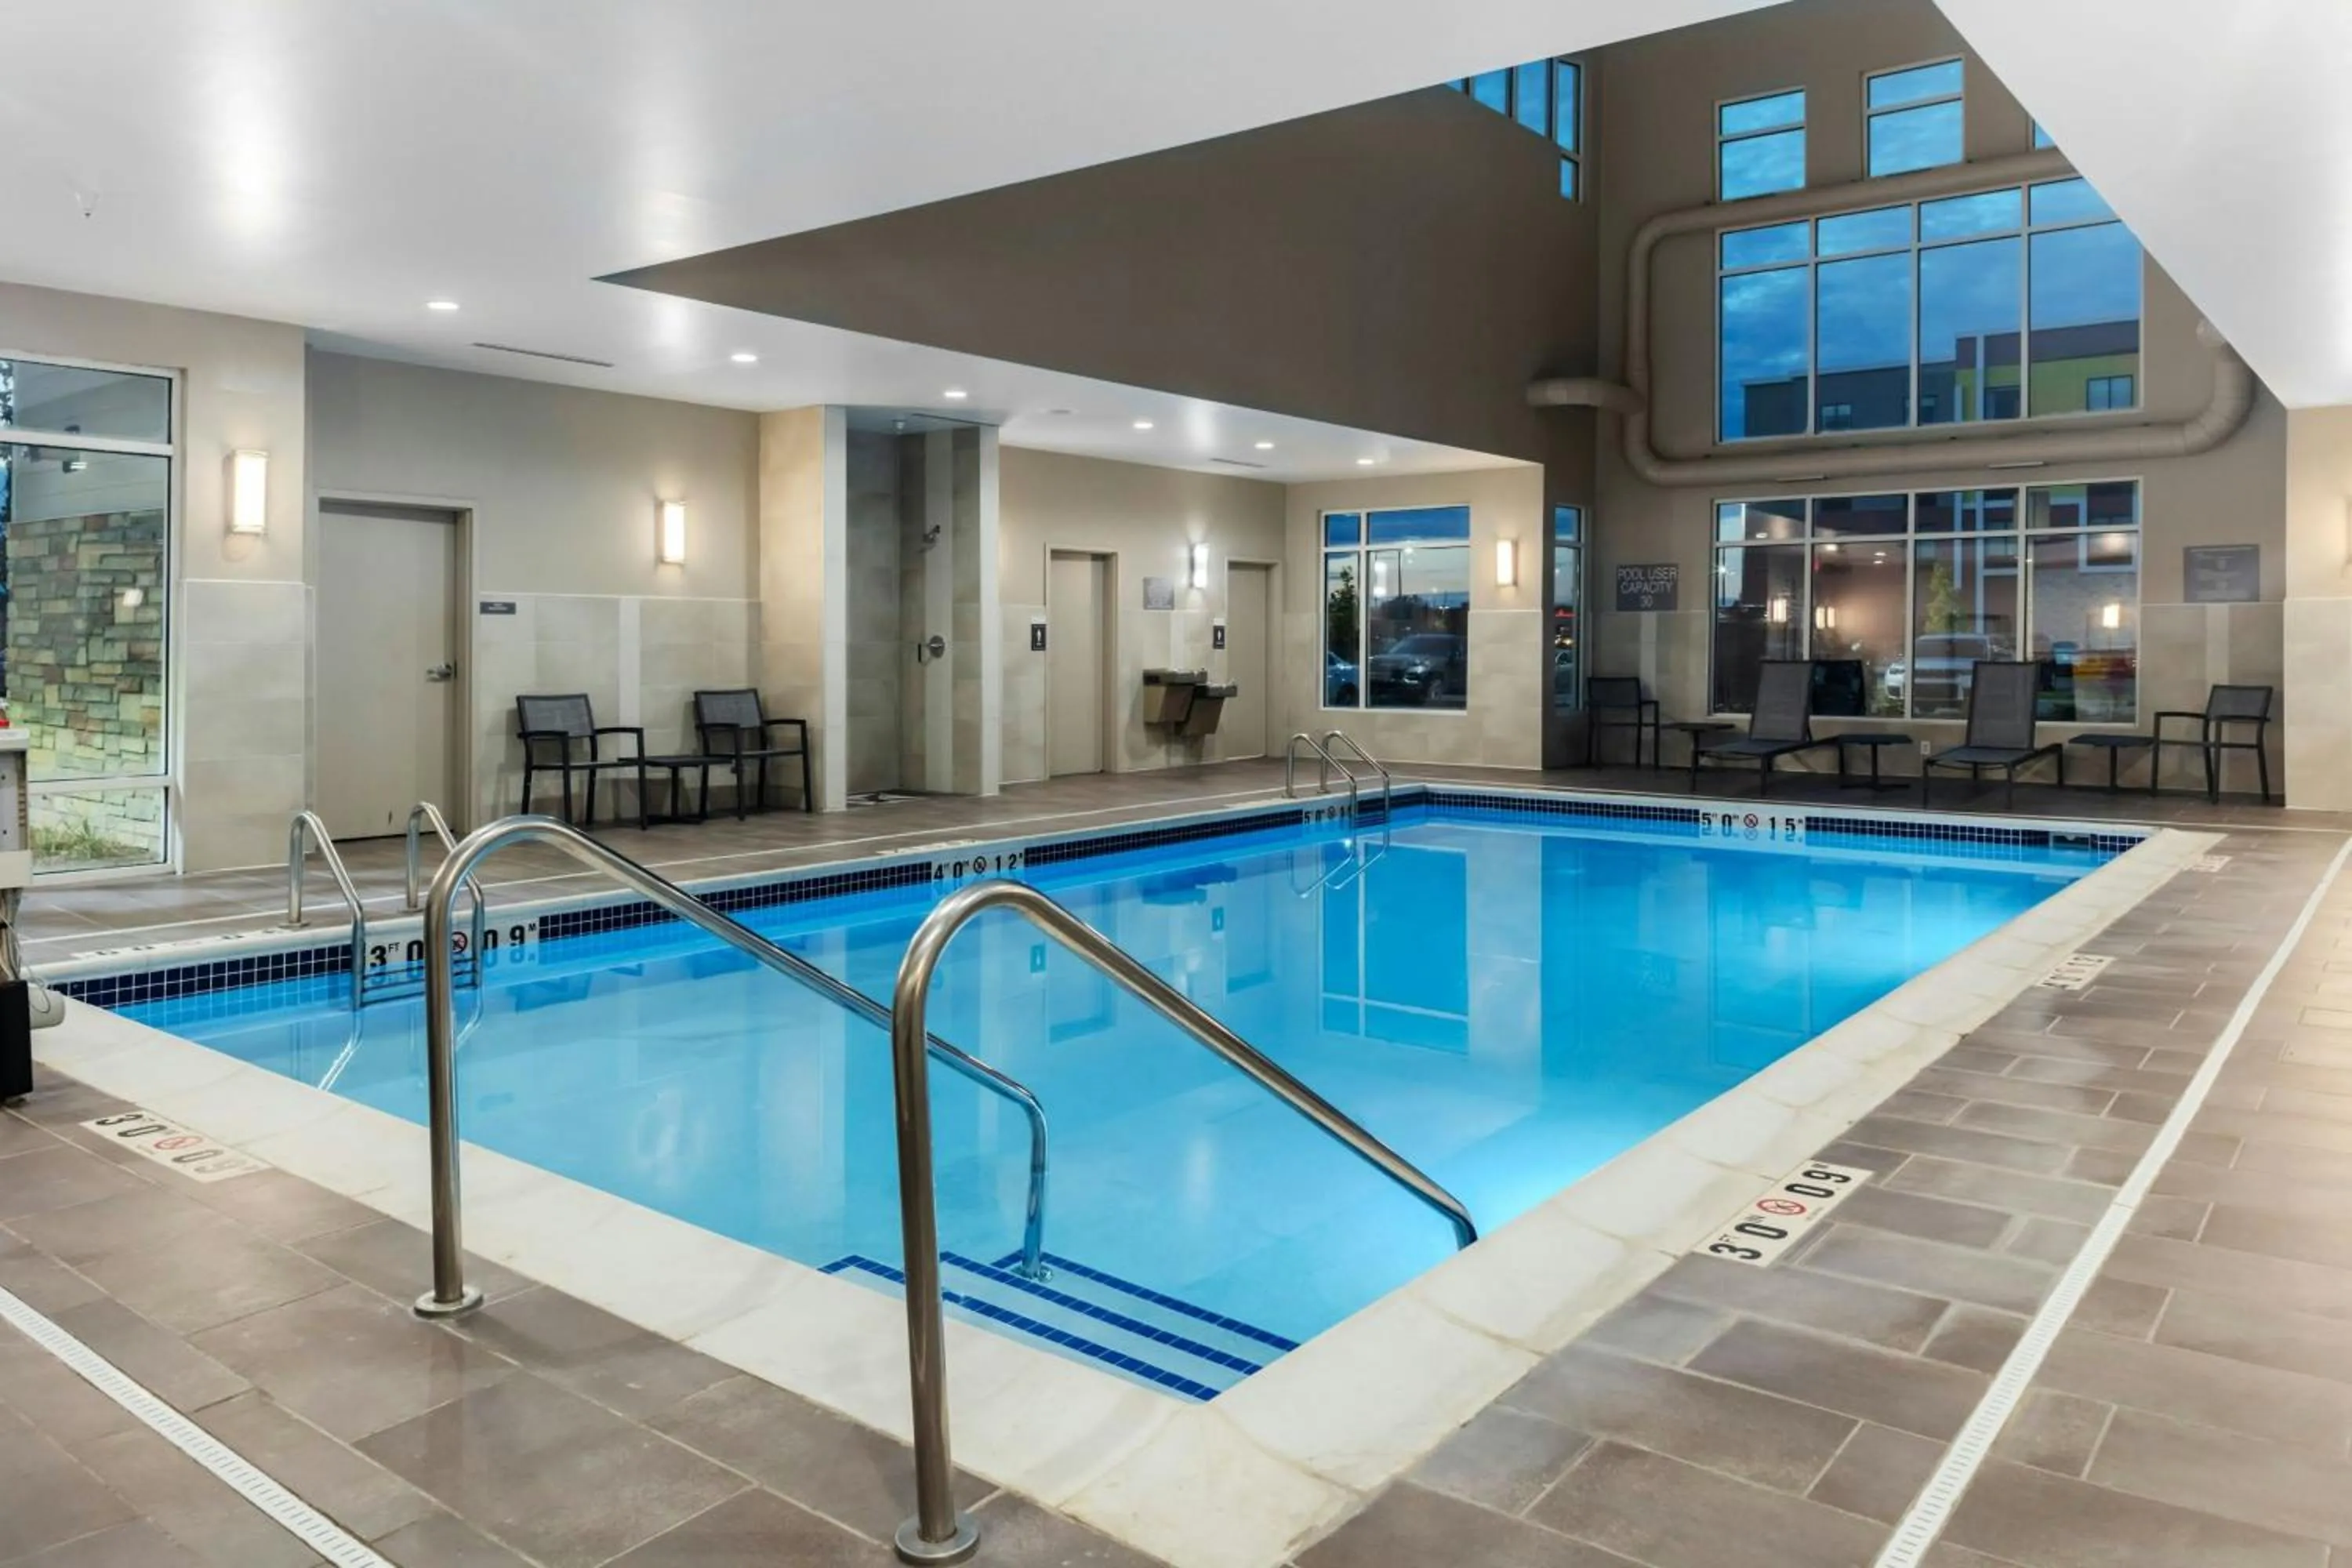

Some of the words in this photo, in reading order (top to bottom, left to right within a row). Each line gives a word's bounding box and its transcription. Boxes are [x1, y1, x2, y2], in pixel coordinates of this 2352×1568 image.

[1618, 568, 1645, 579] POOL
[1648, 567, 1676, 579] USER
[1621, 581, 1672, 593] CAPACITY
